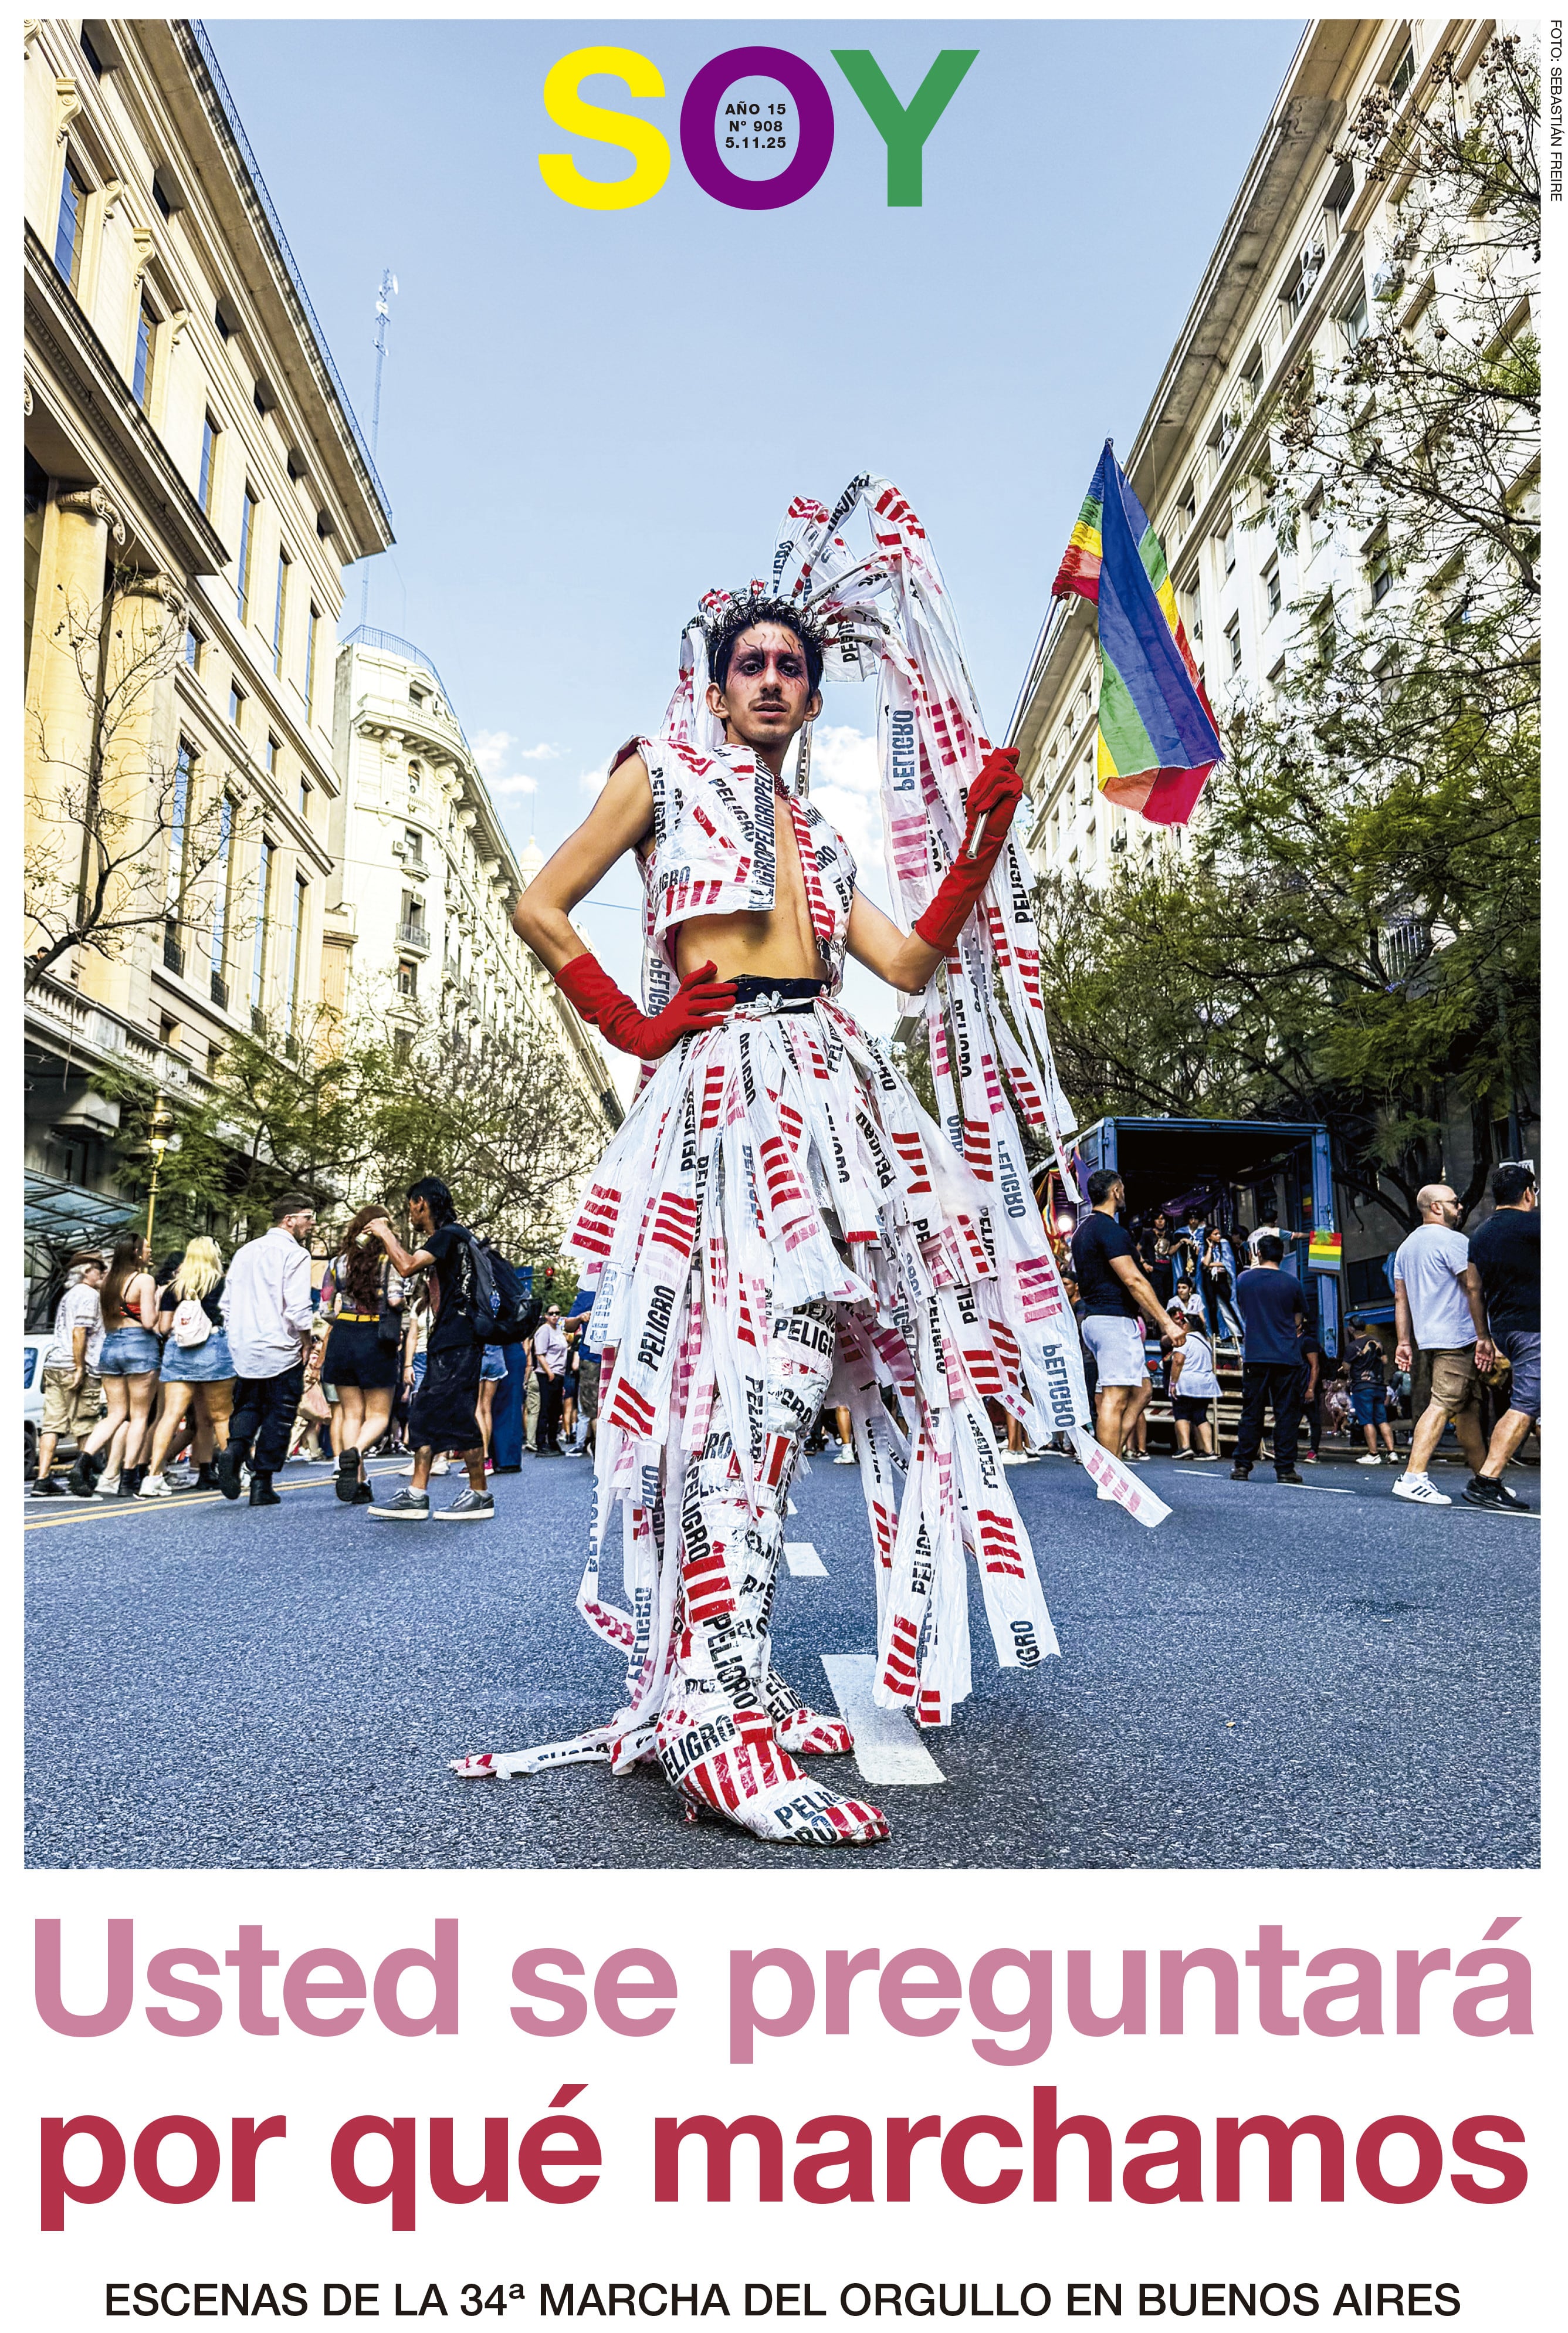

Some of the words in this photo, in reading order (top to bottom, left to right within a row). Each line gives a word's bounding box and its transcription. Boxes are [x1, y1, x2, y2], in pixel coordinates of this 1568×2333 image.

[1007, 843, 1033, 923] PELIGRO
[638, 1285, 676, 1372] PELIGRO
[745, 1375, 764, 1466] PELIGR
[680, 1466, 710, 1563] PELIGRO
[703, 1611, 758, 1709] PELIGRO
[661, 1715, 735, 1784] ELIGRO
